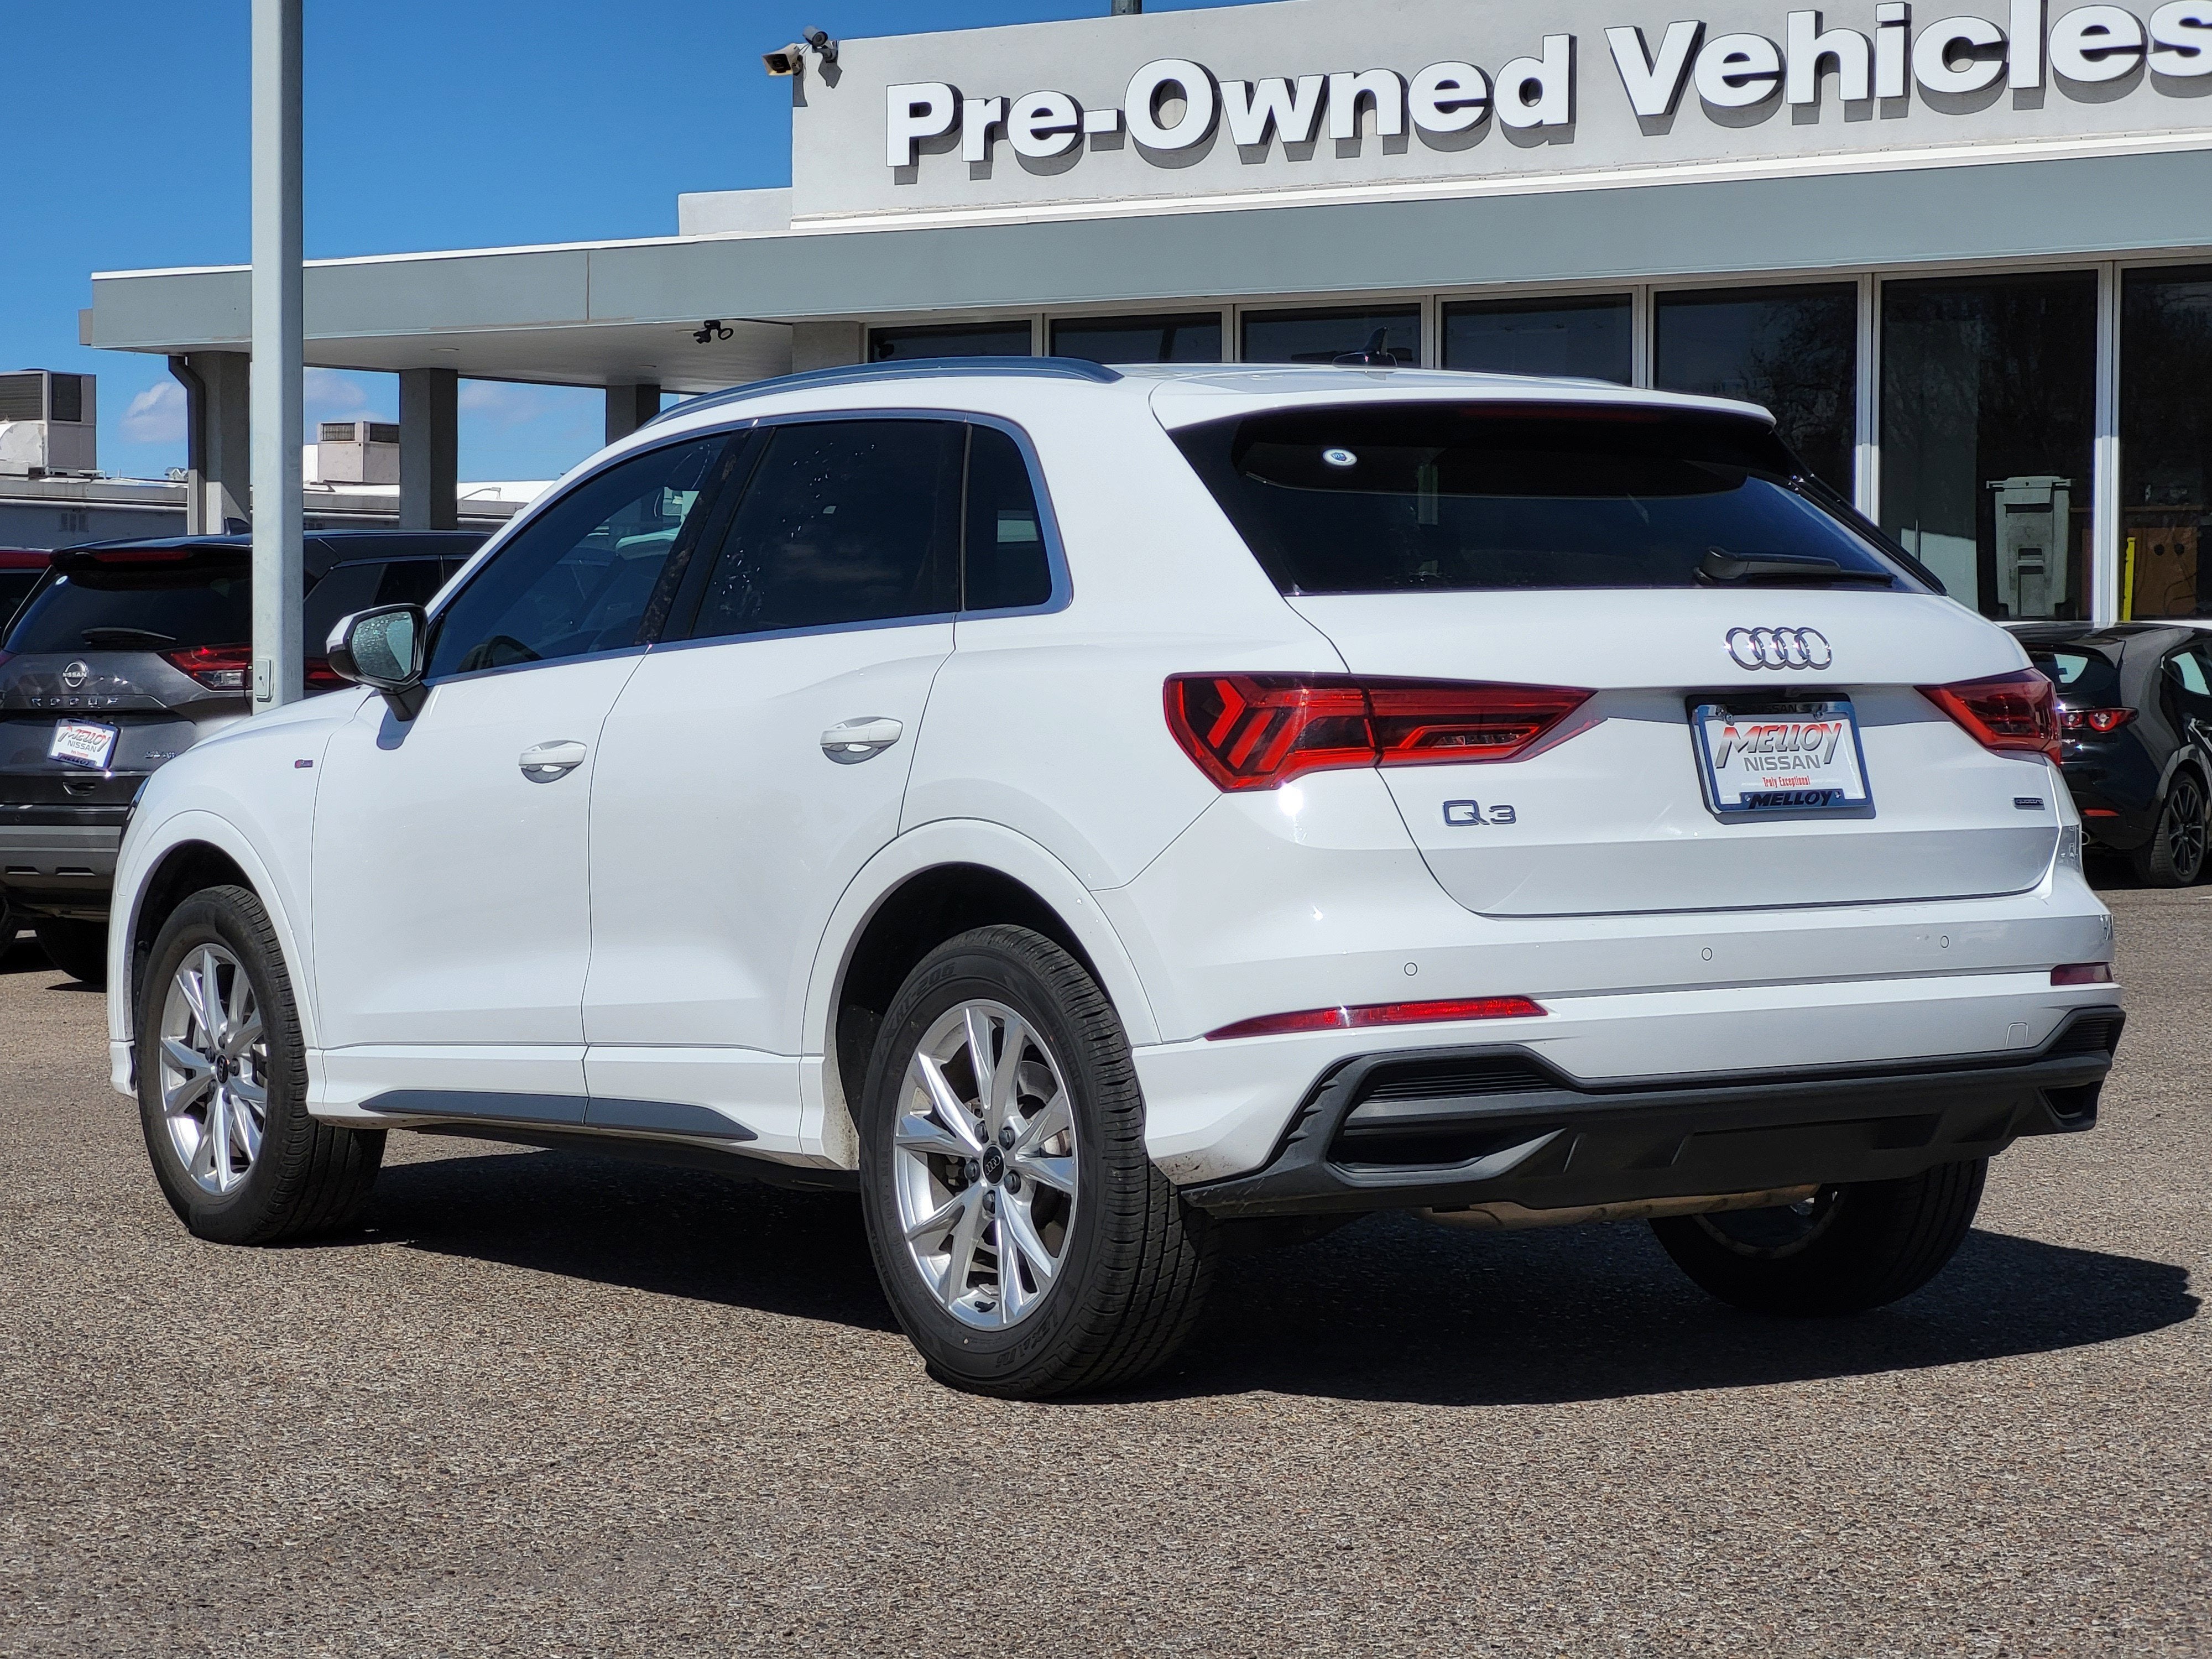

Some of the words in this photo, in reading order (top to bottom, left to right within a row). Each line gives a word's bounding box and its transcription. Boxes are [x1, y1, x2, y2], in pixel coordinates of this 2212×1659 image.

[886, 33, 1577, 168] Pre-Owned
[1604, 0, 2212, 117] Vehicles
[58, 725, 112, 752] MELLOY
[67, 740, 97, 753] NISSAN
[1715, 722, 1842, 769] MELLOY
[1744, 754, 1821, 771] NISSAN
[1762, 776, 1778, 788] Truly
[1778, 775, 1811, 787] Exceptional
[1748, 790, 1834, 810] MELLOY
[1442, 799, 1516, 827] Q3
